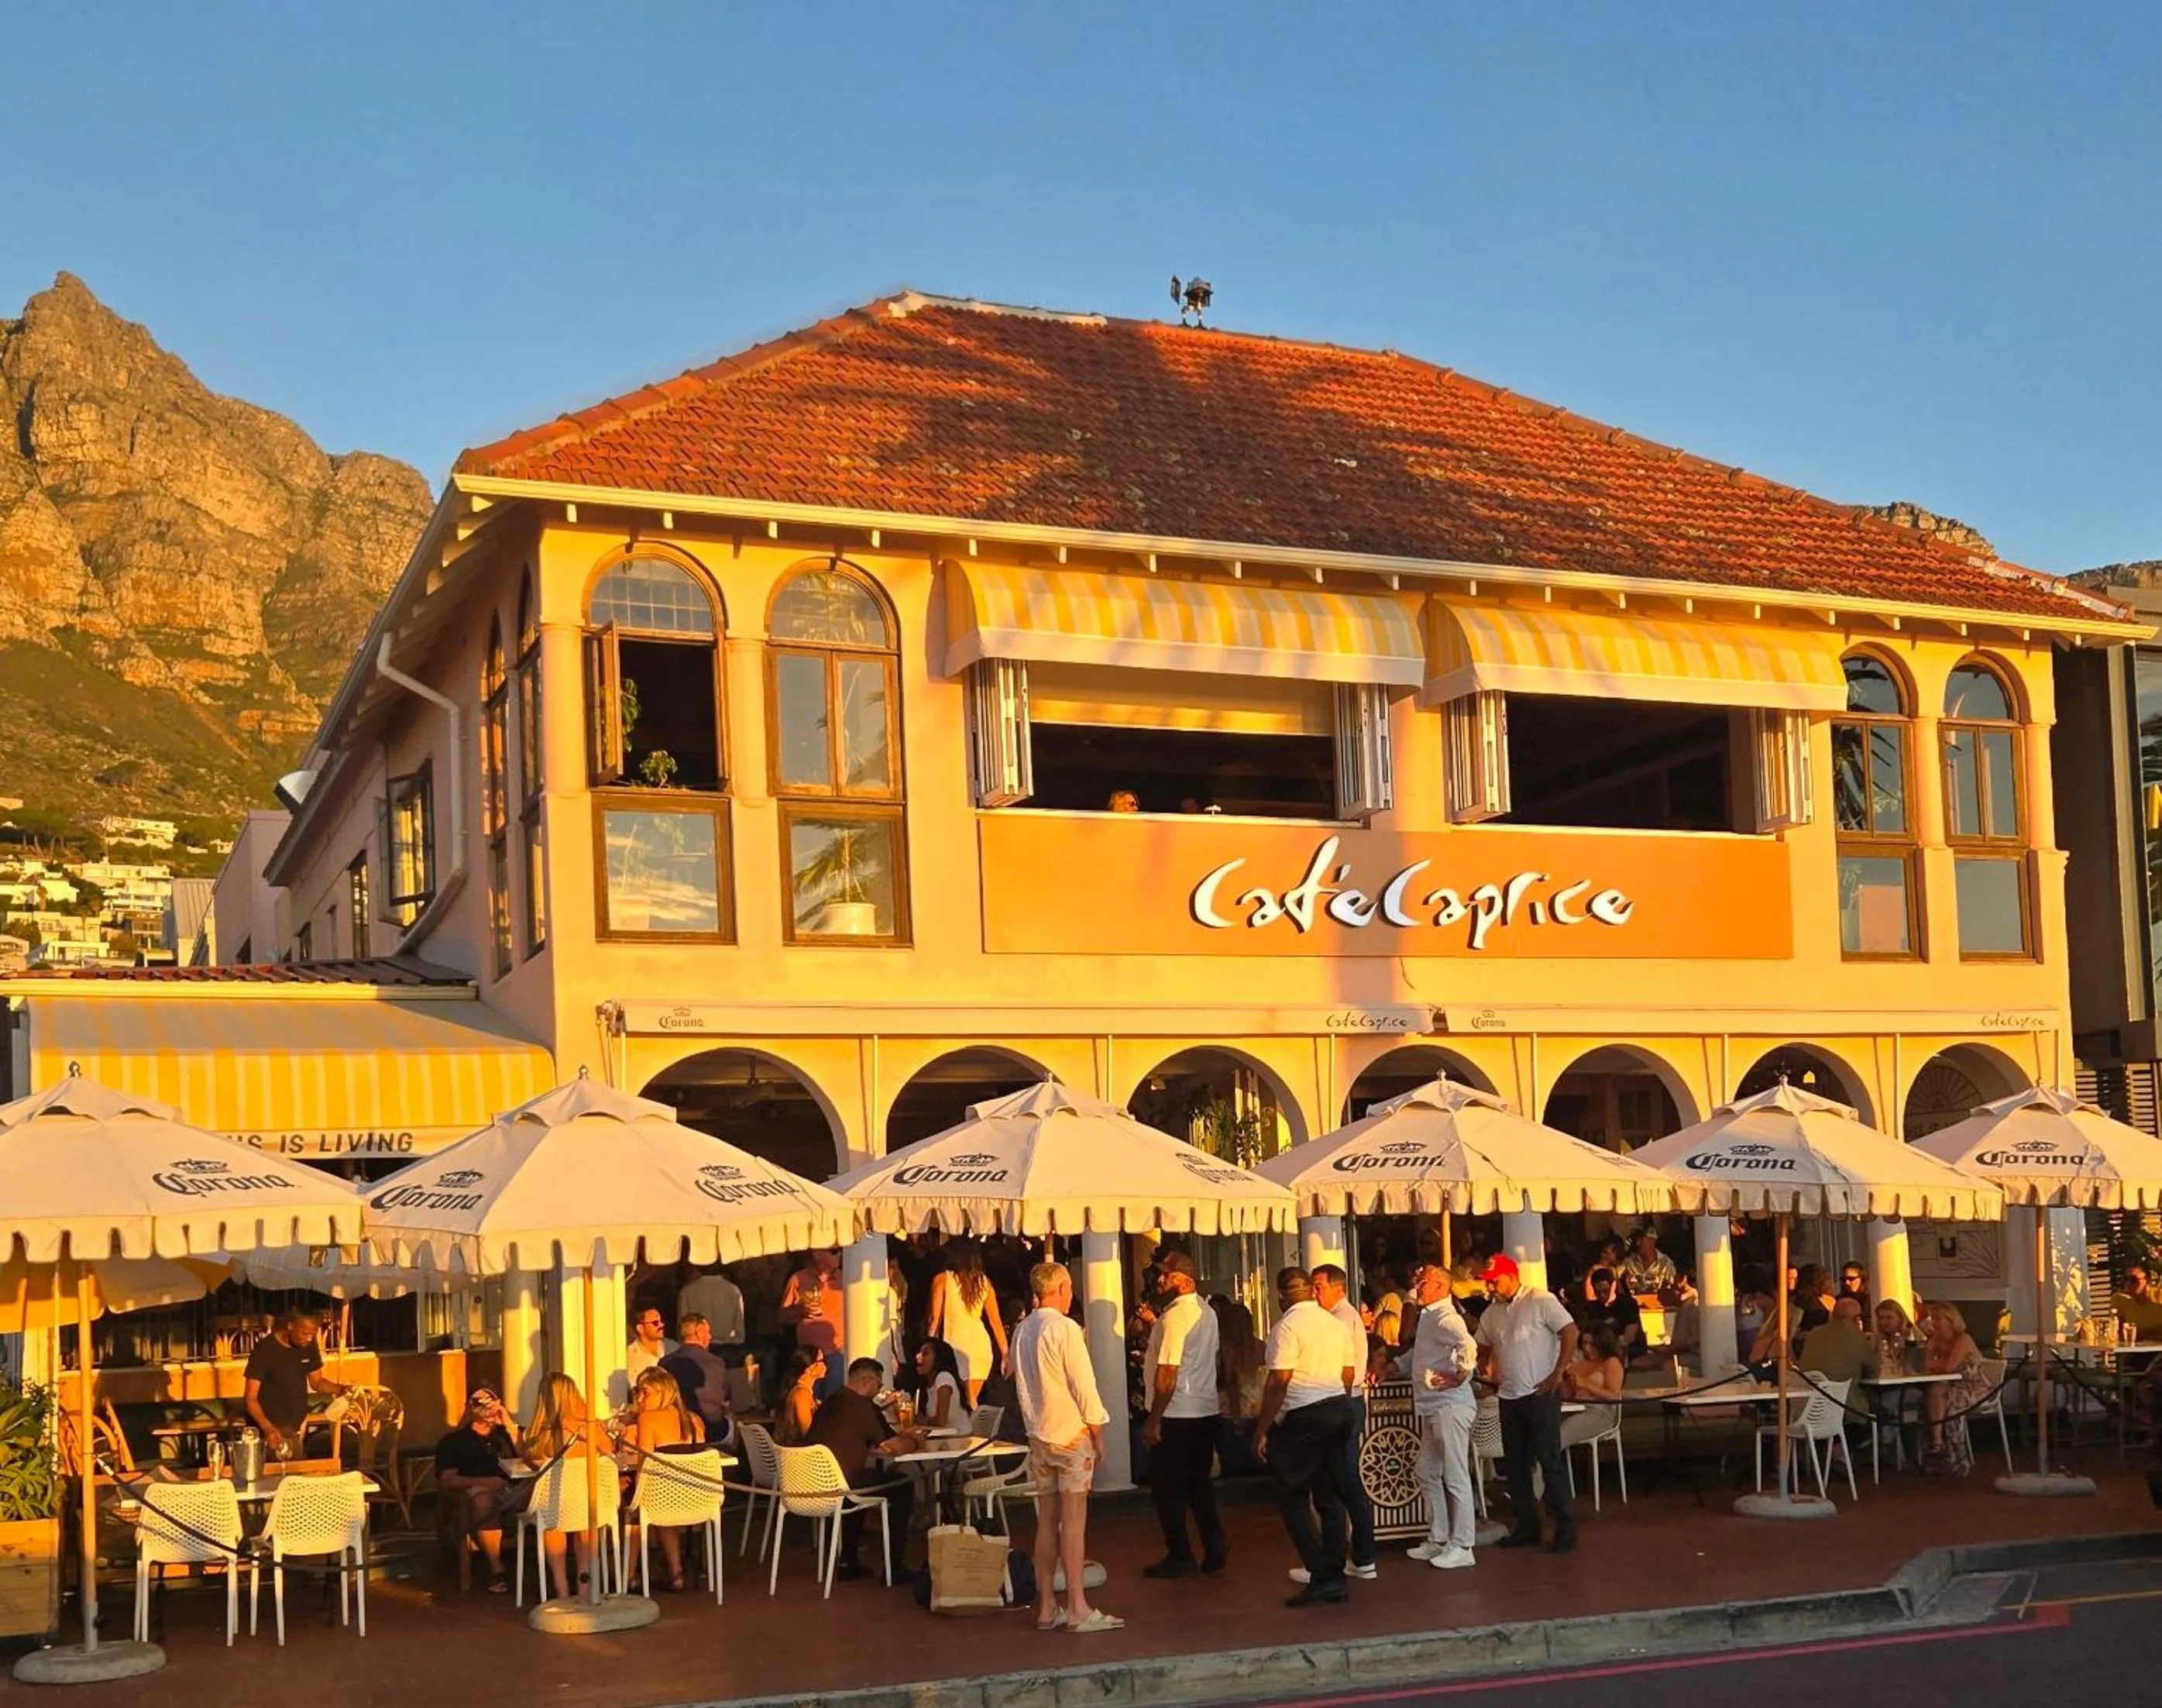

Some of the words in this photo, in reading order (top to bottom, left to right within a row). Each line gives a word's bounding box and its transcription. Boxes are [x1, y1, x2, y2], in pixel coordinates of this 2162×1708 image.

[1380, 858, 1634, 950] Caprice
[280, 1134, 304, 1153] IS
[319, 1132, 414, 1153] LIVING
[1332, 1153, 1445, 1174] Corona
[1686, 1152, 1798, 1172] Corona
[1975, 1150, 2086, 1167] Corona
[152, 1173, 296, 1198] Corona
[893, 1164, 1009, 1187] Corona
[370, 1184, 483, 1212] Corona
[694, 1179, 800, 1205] Corona
